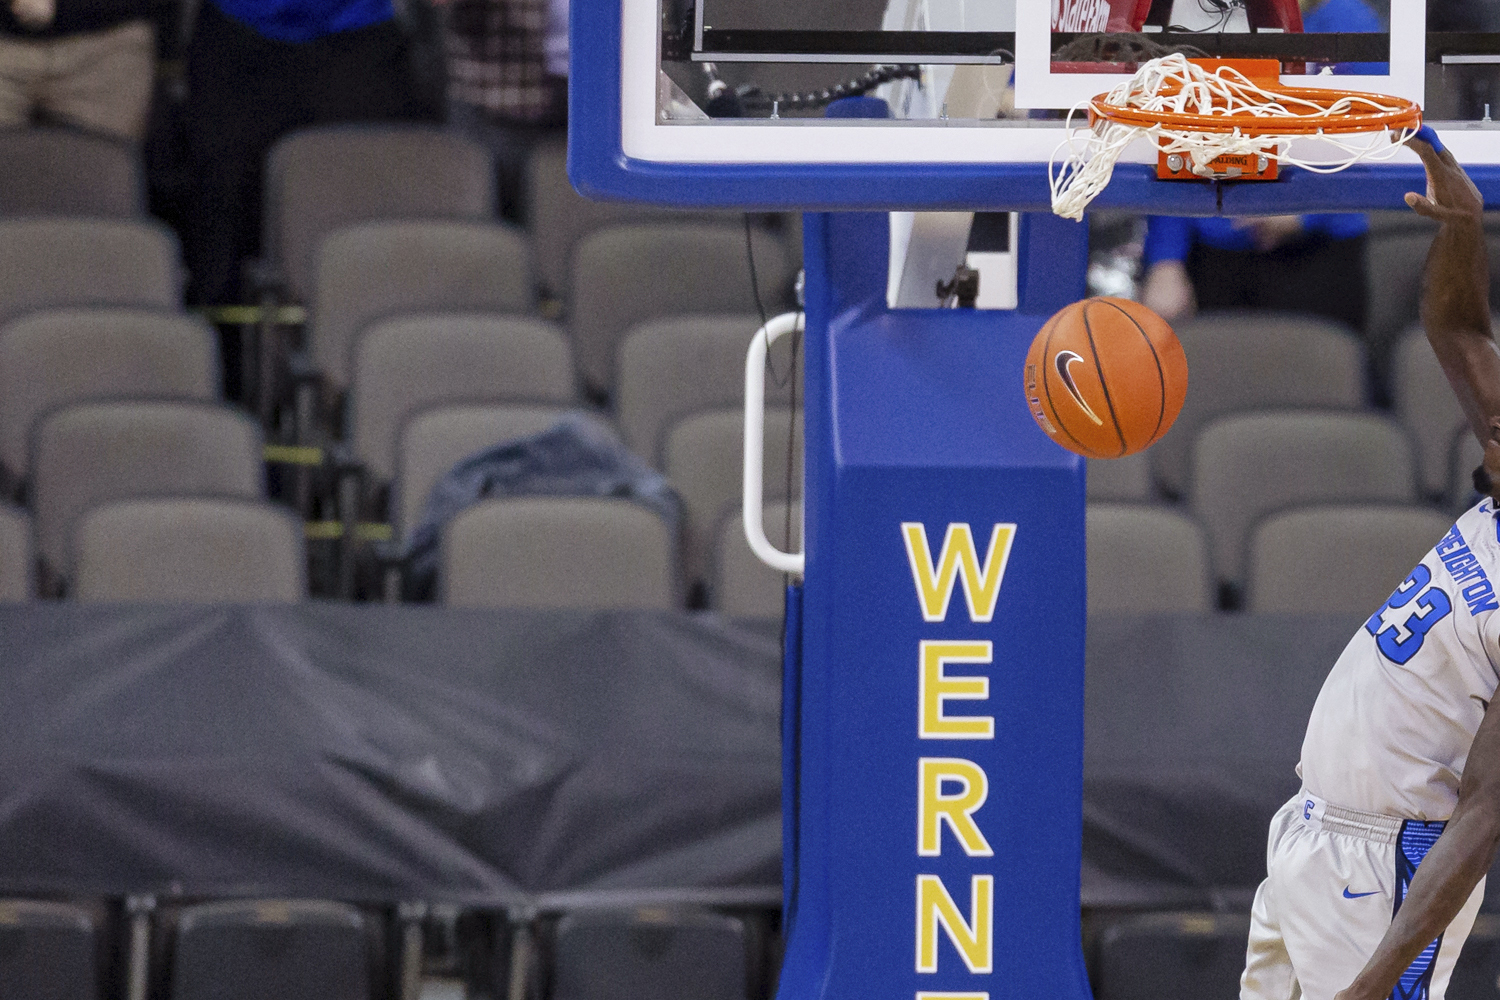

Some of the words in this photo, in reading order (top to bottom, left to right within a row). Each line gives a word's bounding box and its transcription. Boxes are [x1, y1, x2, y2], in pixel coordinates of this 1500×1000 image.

[1210, 155, 1248, 166] ALDING
[1365, 563, 1453, 666] 23
[1436, 522, 1499, 617] REIGHTON
